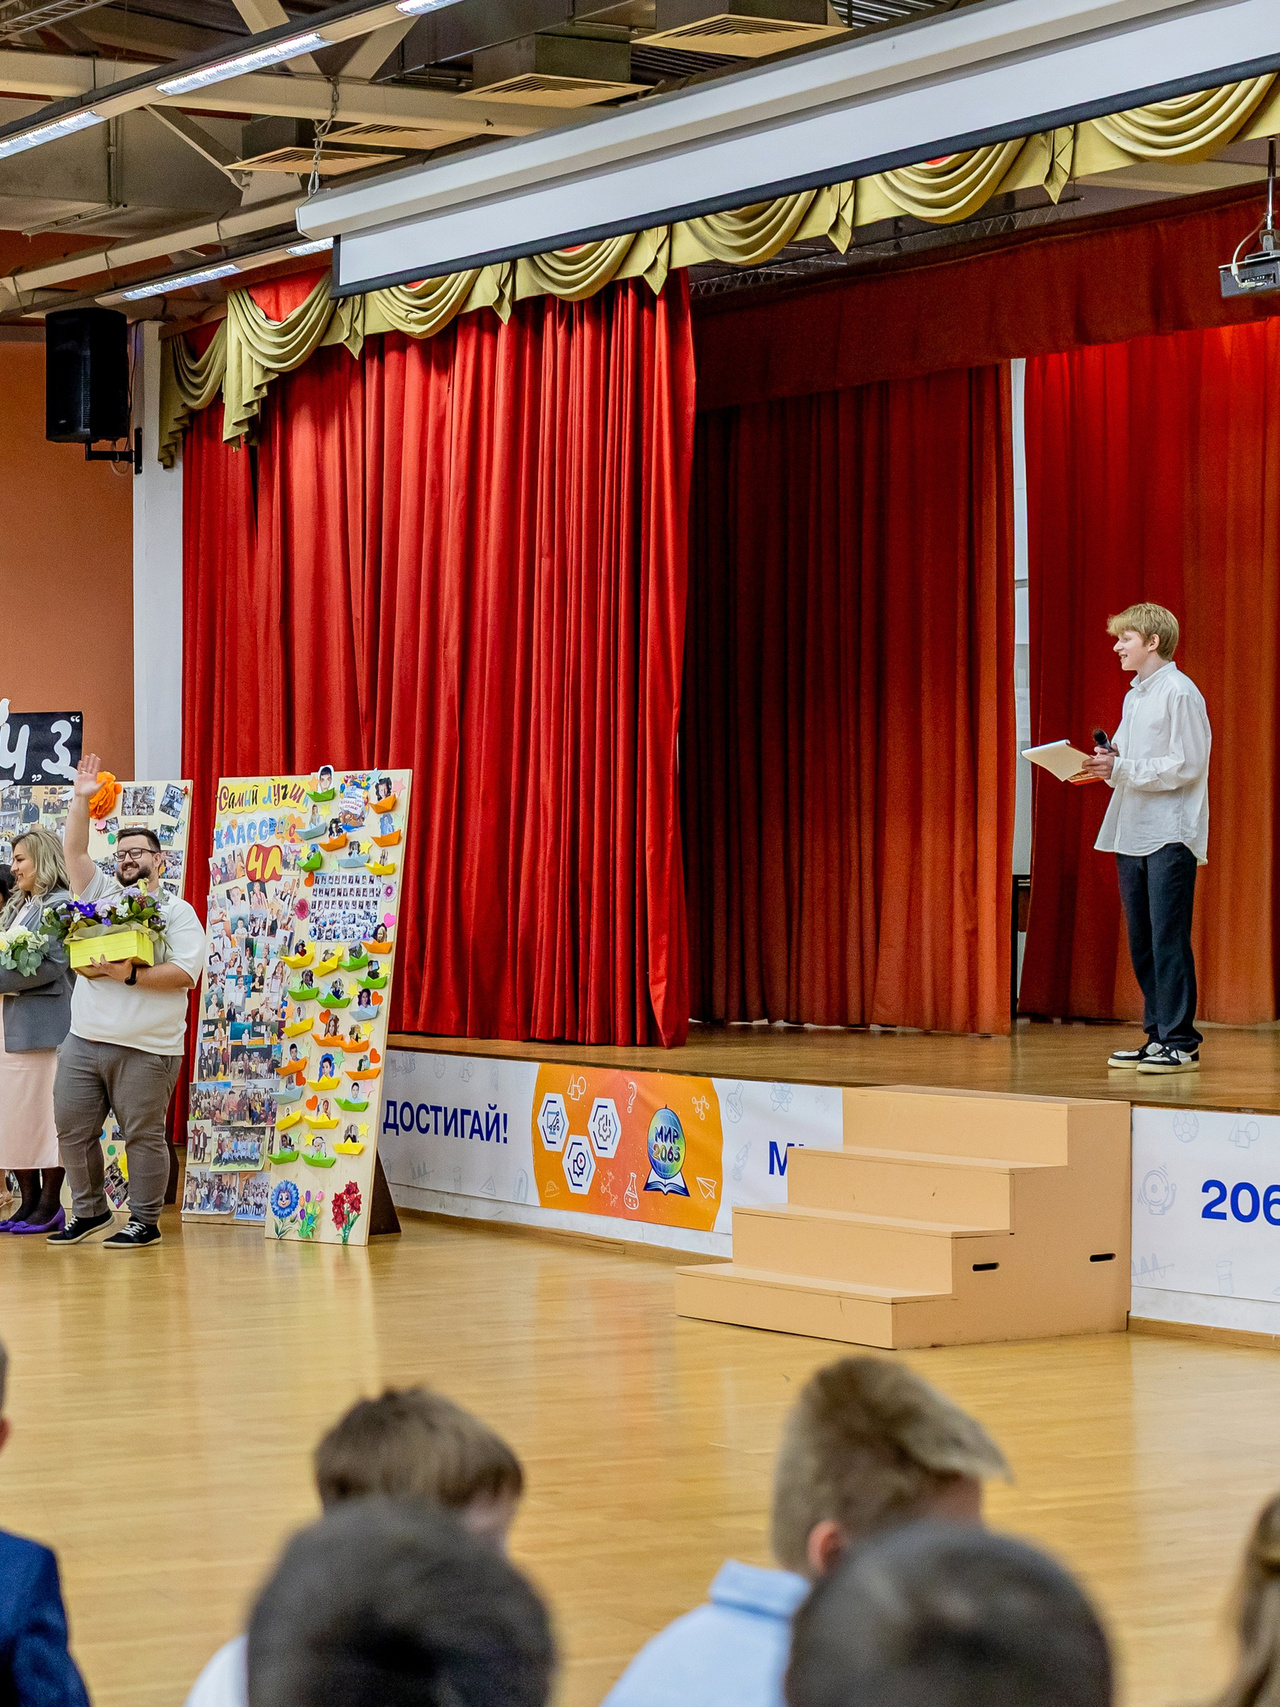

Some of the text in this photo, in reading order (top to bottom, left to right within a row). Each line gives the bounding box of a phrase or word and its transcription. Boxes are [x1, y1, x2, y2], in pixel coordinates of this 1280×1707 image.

[382, 1099, 508, 1144] ДОСТИГАЙ!
[654, 1125, 680, 1144] МИР
[652, 1143, 681, 1163] 2065
